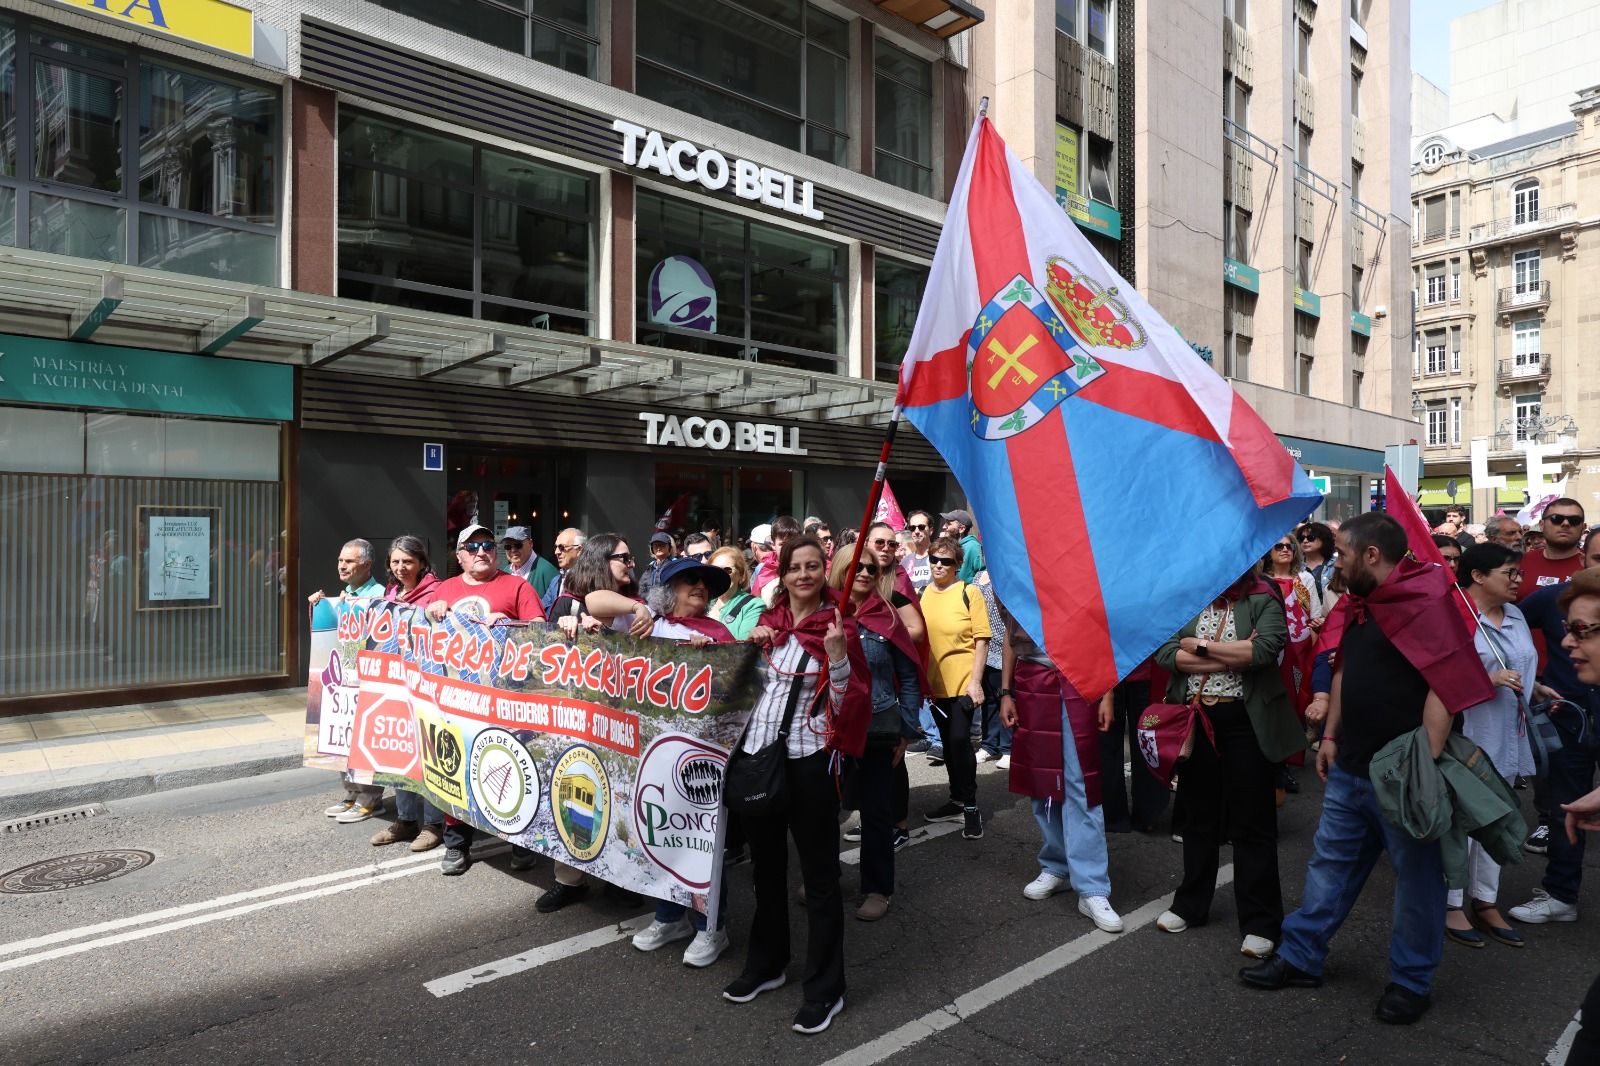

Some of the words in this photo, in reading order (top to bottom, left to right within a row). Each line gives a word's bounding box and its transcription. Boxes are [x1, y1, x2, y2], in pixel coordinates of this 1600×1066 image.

[613, 119, 729, 190] TACO
[735, 158, 824, 221] BELL
[1224, 262, 1238, 279] ser
[33, 356, 114, 376] MAESTRÍA
[119, 364, 128, 376] Y
[33, 372, 128, 393] EXCELENCIA
[131, 382, 185, 398] DENTAL
[639, 412, 731, 450] TACO
[735, 421, 808, 456] BELL
[1471, 436, 1508, 490] L
[912, 568, 929, 577] VI'S
[411, 625, 495, 674] TIERRA
[498, 637, 533, 682] DE
[539, 643, 712, 714] SACRIFICIO
[327, 721, 353, 748] LEÓ
[373, 714, 415, 739] STOP
[496, 697, 550, 726] VERTEDEROS
[551, 701, 587, 730] TÓXICOS
[592, 712, 609, 739] STOP
[609, 719, 635, 749] BIOGÁS
[371, 736, 414, 754] LODOS
[472, 754, 480, 781] TREN
[476, 735, 494, 752] RUTA
[496, 735, 508, 746] DE
[510, 744, 519, 758] LA
[519, 758, 532, 795] PLATA
[554, 750, 589, 788] PLATAFORMA
[484, 806, 521, 827] Movimiento
[686, 836, 715, 854] LLION
